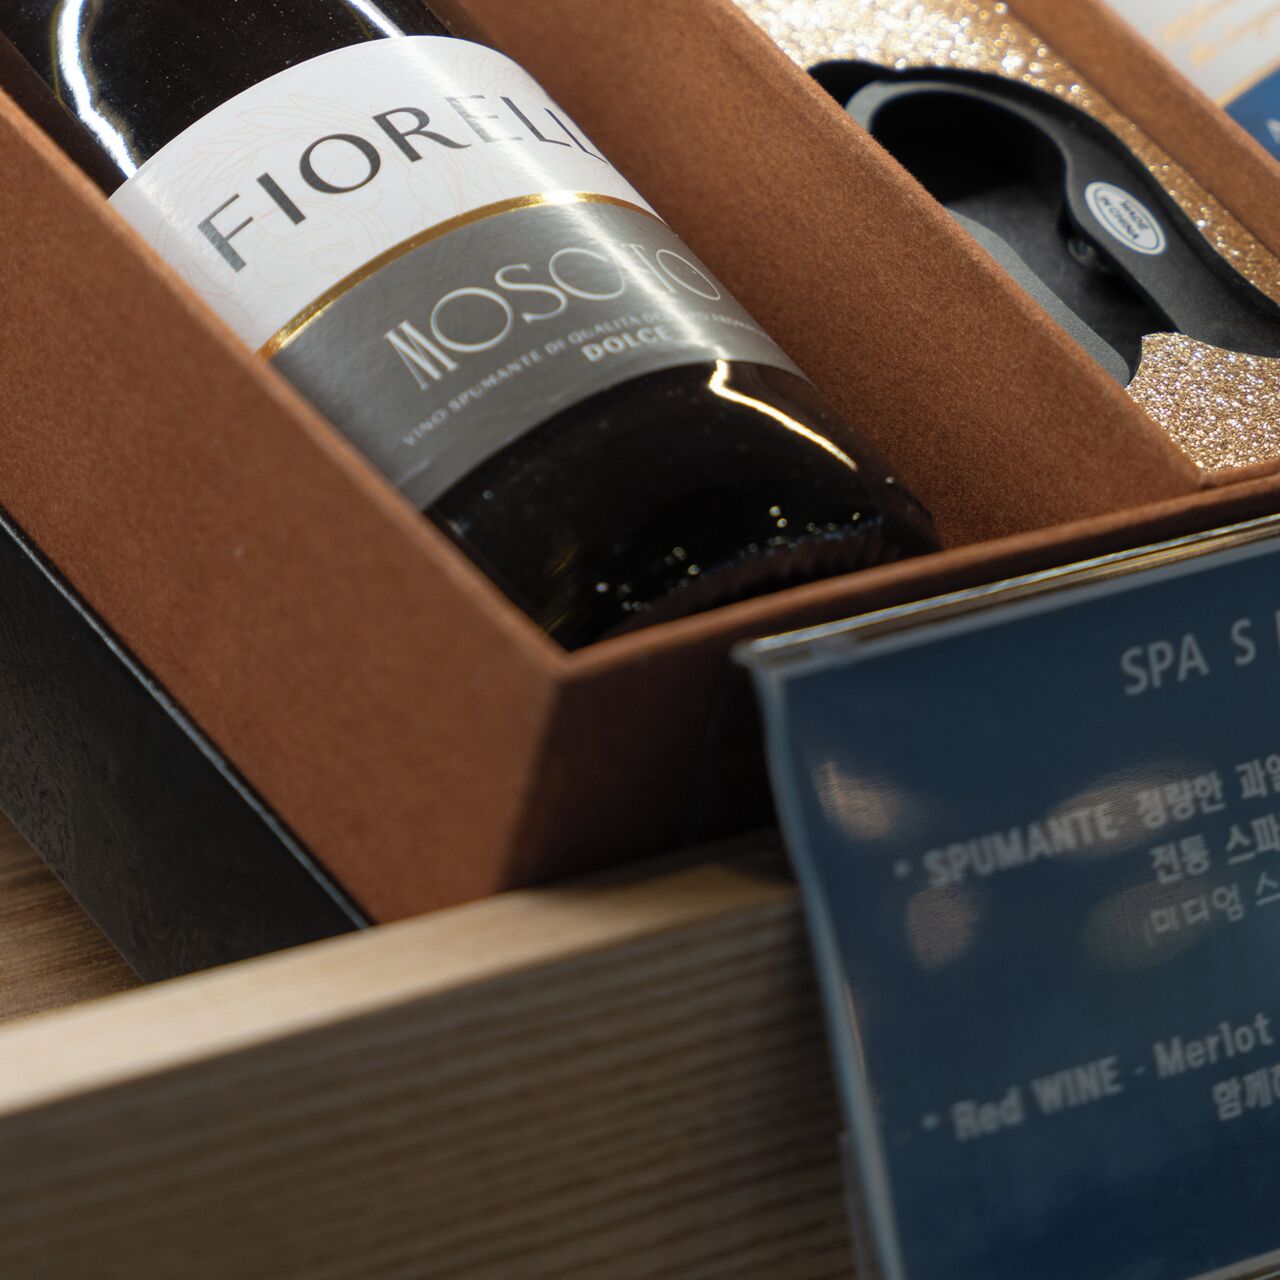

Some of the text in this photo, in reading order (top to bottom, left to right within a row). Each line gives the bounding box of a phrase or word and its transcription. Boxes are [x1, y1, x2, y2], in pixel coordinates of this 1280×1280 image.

[385, 244, 721, 390] MOSCTO
[581, 324, 674, 364] DOLCE
[402, 407, 449, 447] VINO
[449, 350, 543, 414] SPUMANTE
[1120, 632, 1210, 697] SPA
[923, 803, 1115, 888] SPUMANTE
[1148, 833, 1210, 885] 전통
[950, 1086, 1024, 1142] Red
[1029, 1054, 1123, 1116] WINE
[1152, 1012, 1274, 1080] Merlot
